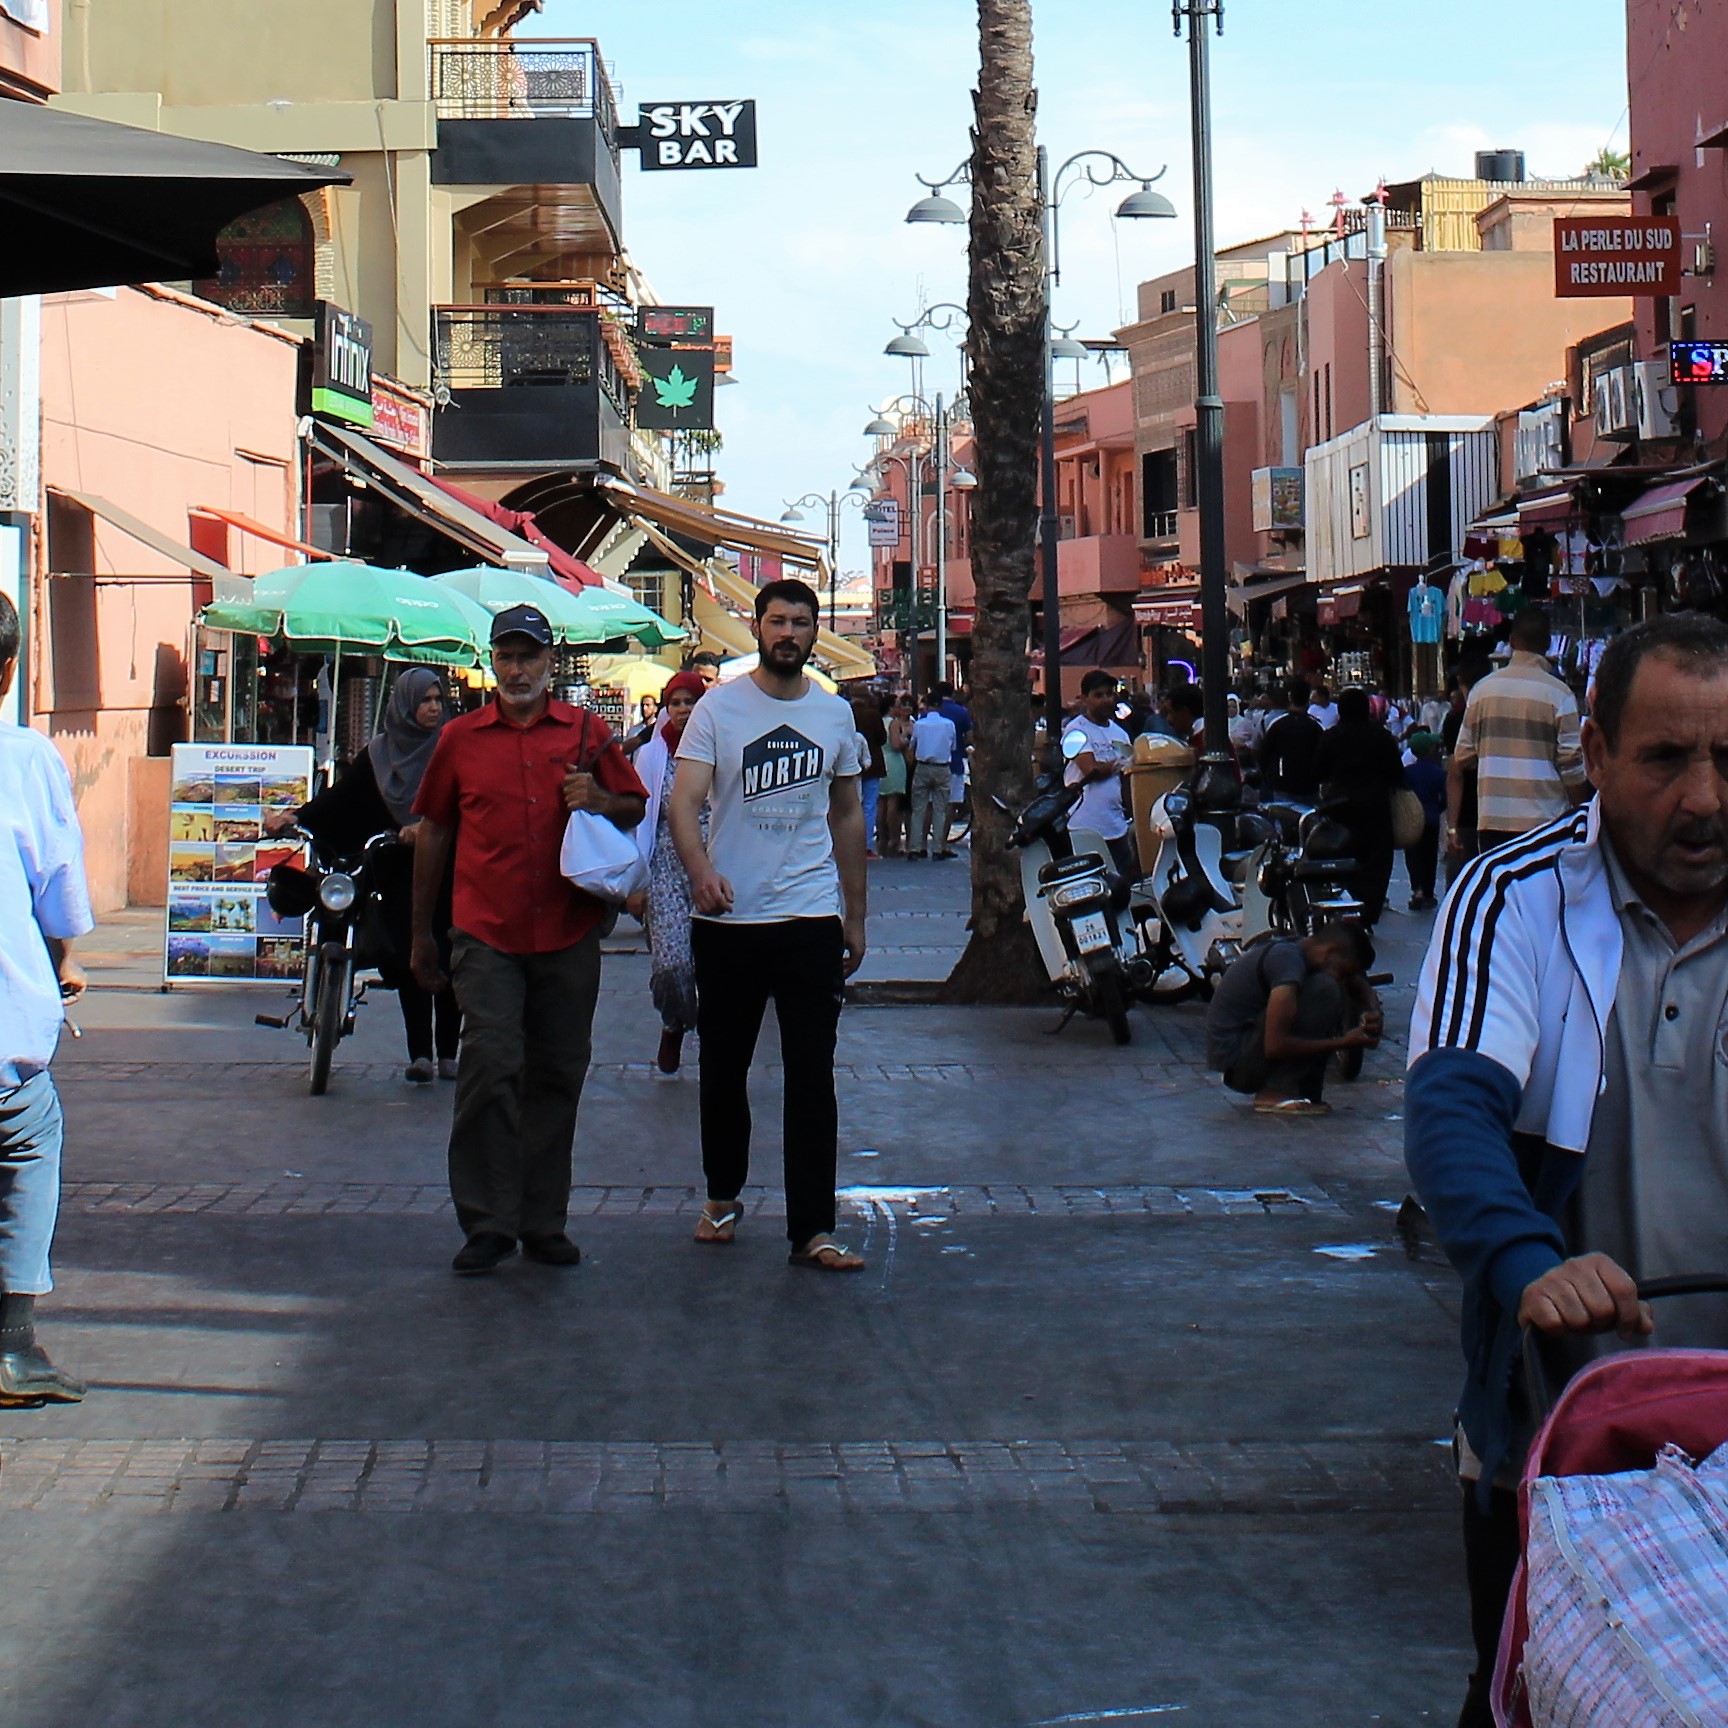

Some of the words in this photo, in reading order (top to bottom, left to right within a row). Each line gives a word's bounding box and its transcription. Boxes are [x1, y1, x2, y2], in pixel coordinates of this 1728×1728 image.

[650, 104, 745, 138] SKY
[658, 139, 740, 166] BAR
[1561, 230, 1579, 252] LA
[1581, 229, 1622, 251] PERLE
[1624, 228, 1643, 250] DU
[1646, 228, 1673, 250] SUD
[1570, 261, 1665, 284] RESTAURANT
[767, 740, 800, 749] CHICAGO
[214, 765, 246, 773] DESERT
[248, 766, 267, 774] TRIP
[744, 747, 820, 796] NORTH
